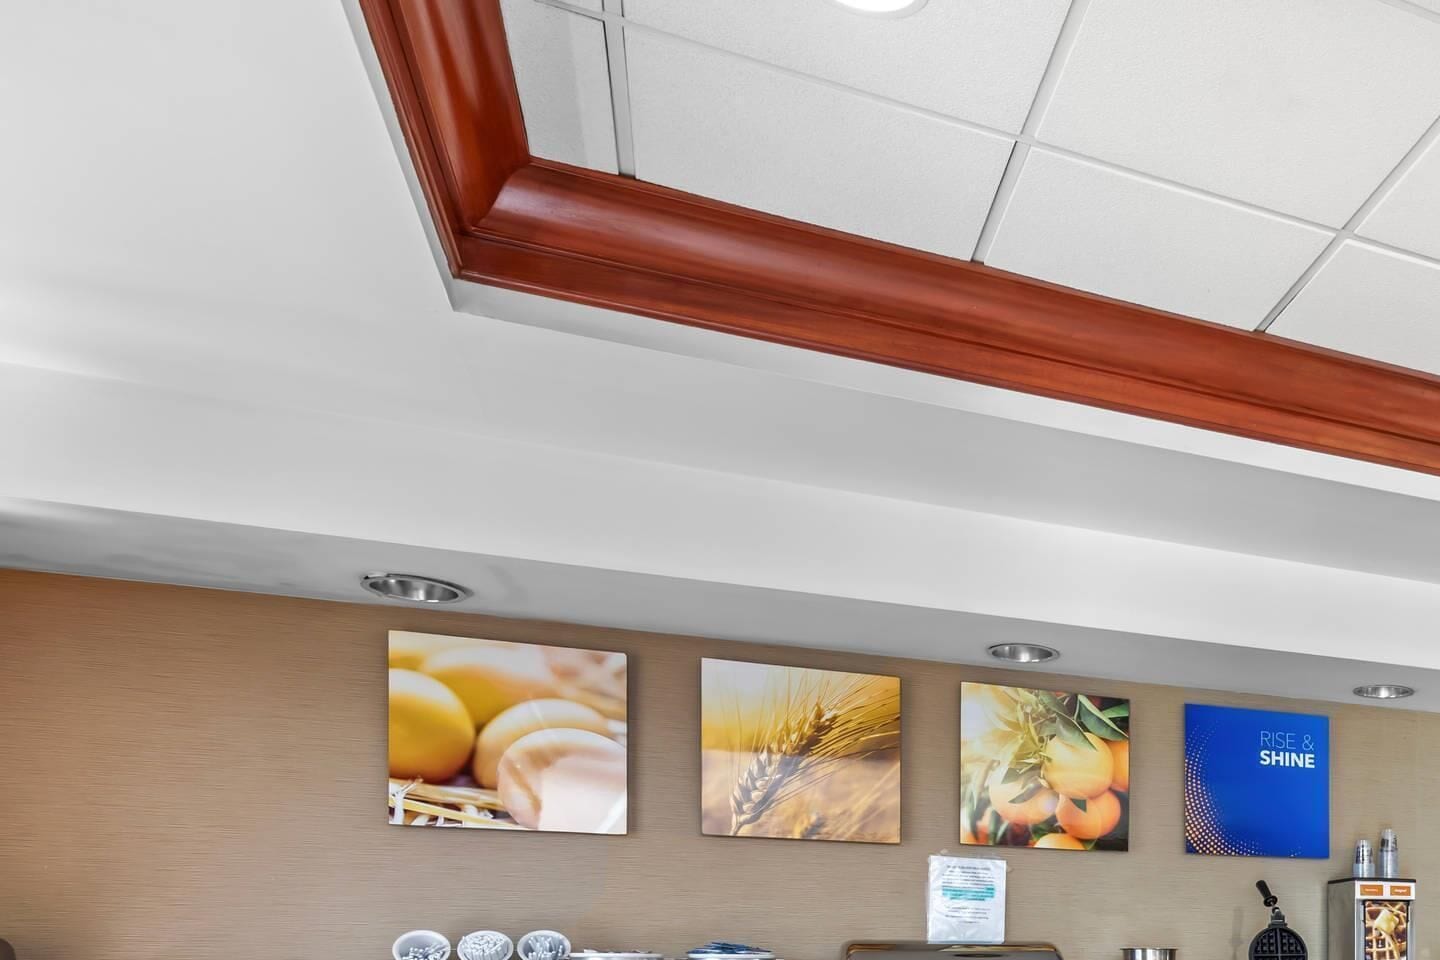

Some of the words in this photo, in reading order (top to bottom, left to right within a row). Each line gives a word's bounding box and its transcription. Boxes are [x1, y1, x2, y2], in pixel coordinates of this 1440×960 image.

[1260, 731, 1296, 750] RISE
[1302, 734, 1315, 751] &
[1260, 750, 1315, 769] SHINE
